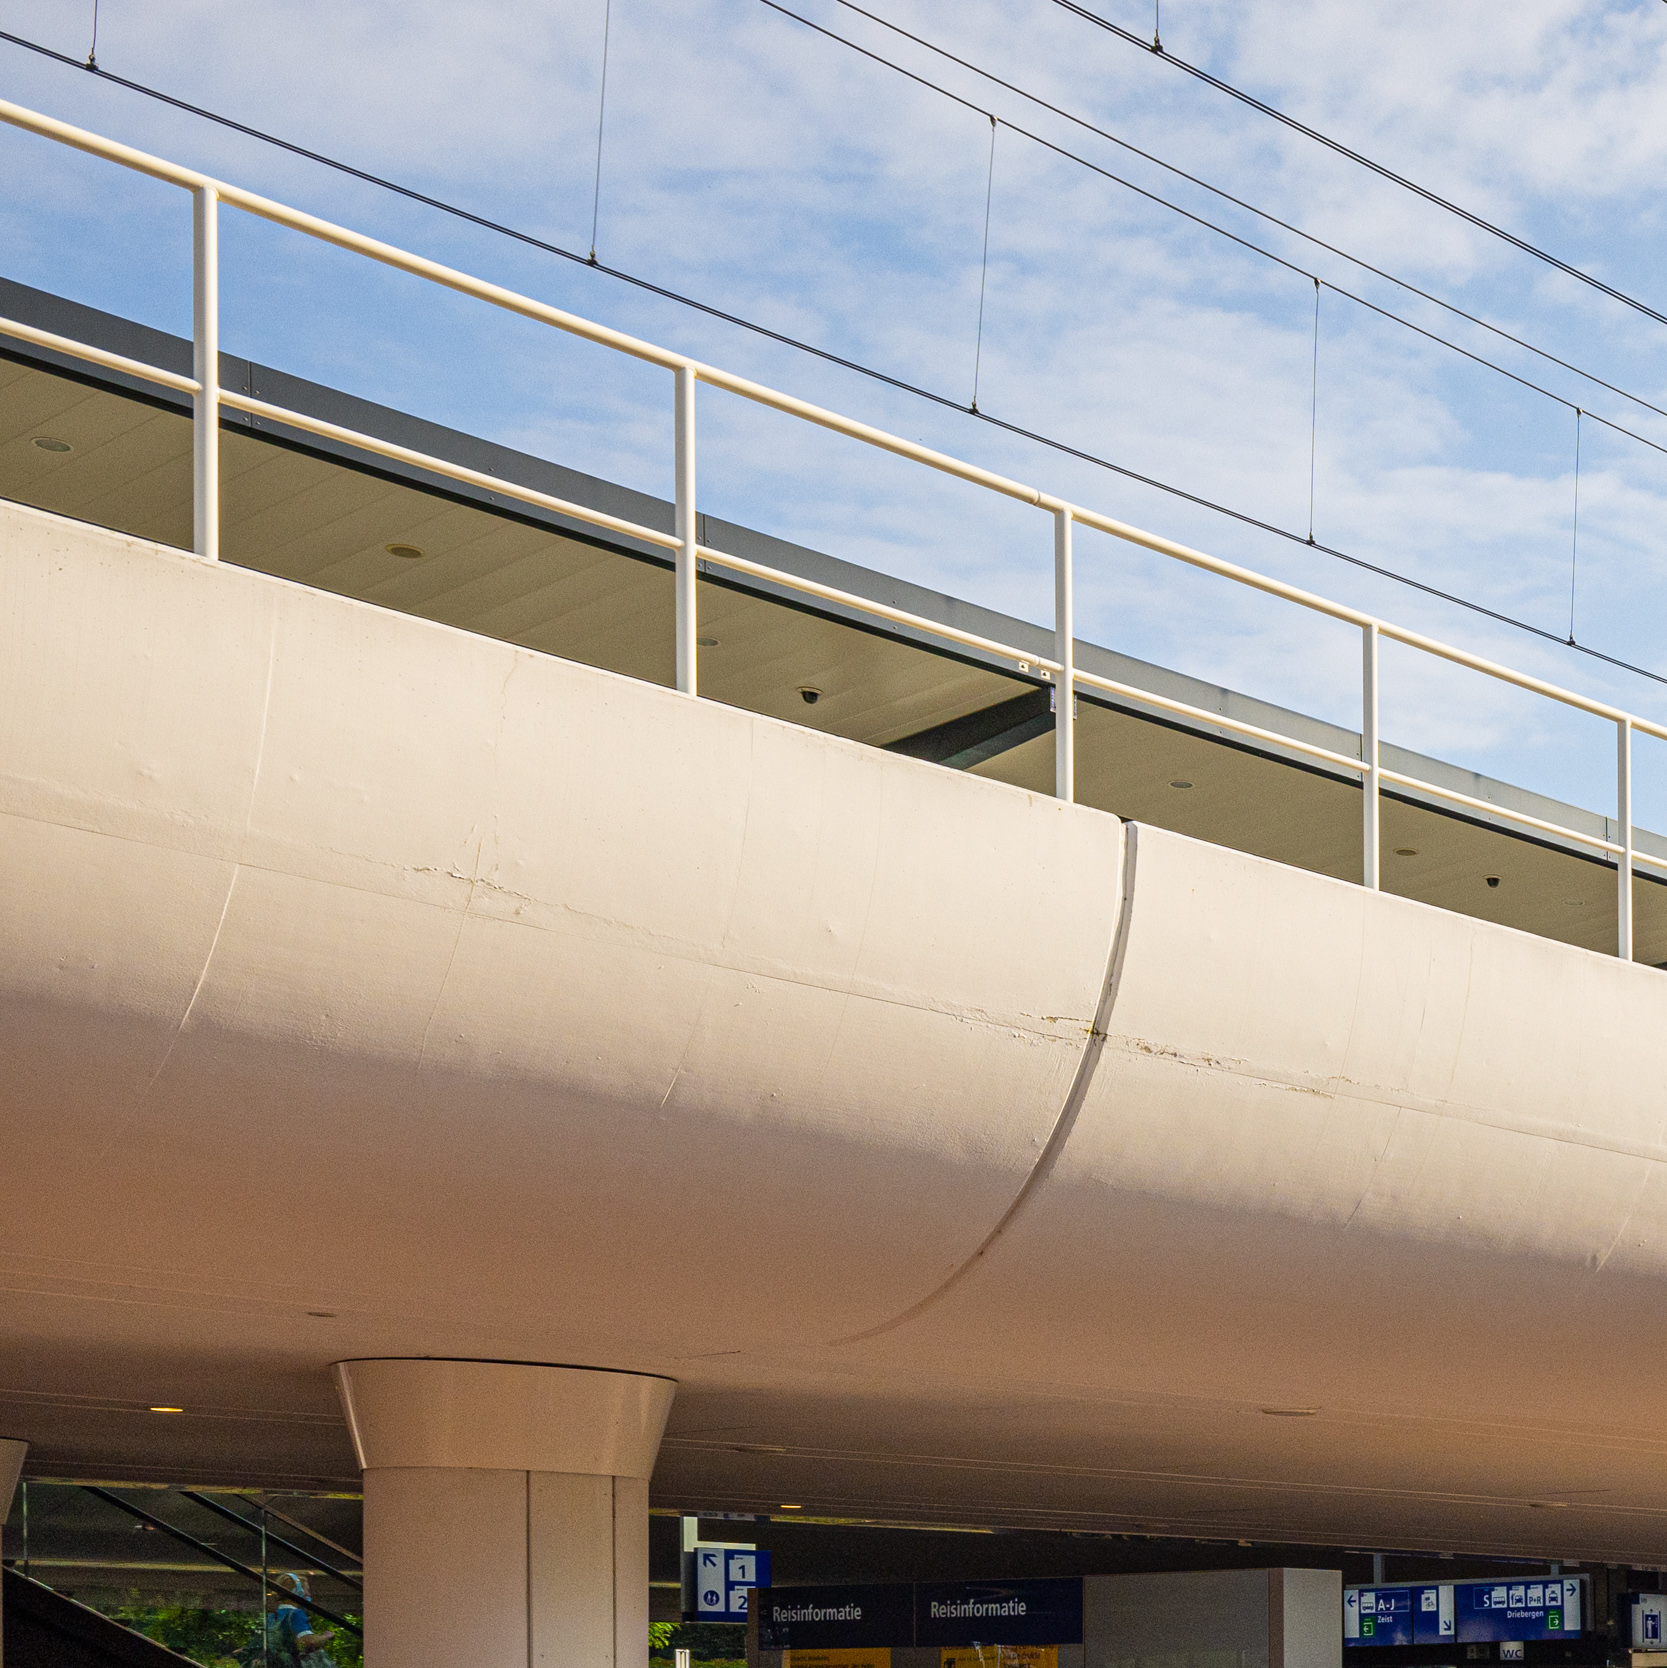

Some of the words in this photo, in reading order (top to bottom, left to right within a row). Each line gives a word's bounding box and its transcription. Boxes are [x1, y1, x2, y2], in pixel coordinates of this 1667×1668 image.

[738, 1564, 746, 1579] 1
[737, 1595, 747, 1609] 2
[1377, 1599, 1396, 1611] A-J
[1483, 1595, 1490, 1607] S
[773, 1603, 862, 1623] Reisinformatie
[931, 1598, 1027, 1619] Reisinformatie
[1377, 1614, 1393, 1623] Zeist
[1507, 1610, 1545, 1620] Driebergen
[1502, 1649, 1522, 1658] WC
